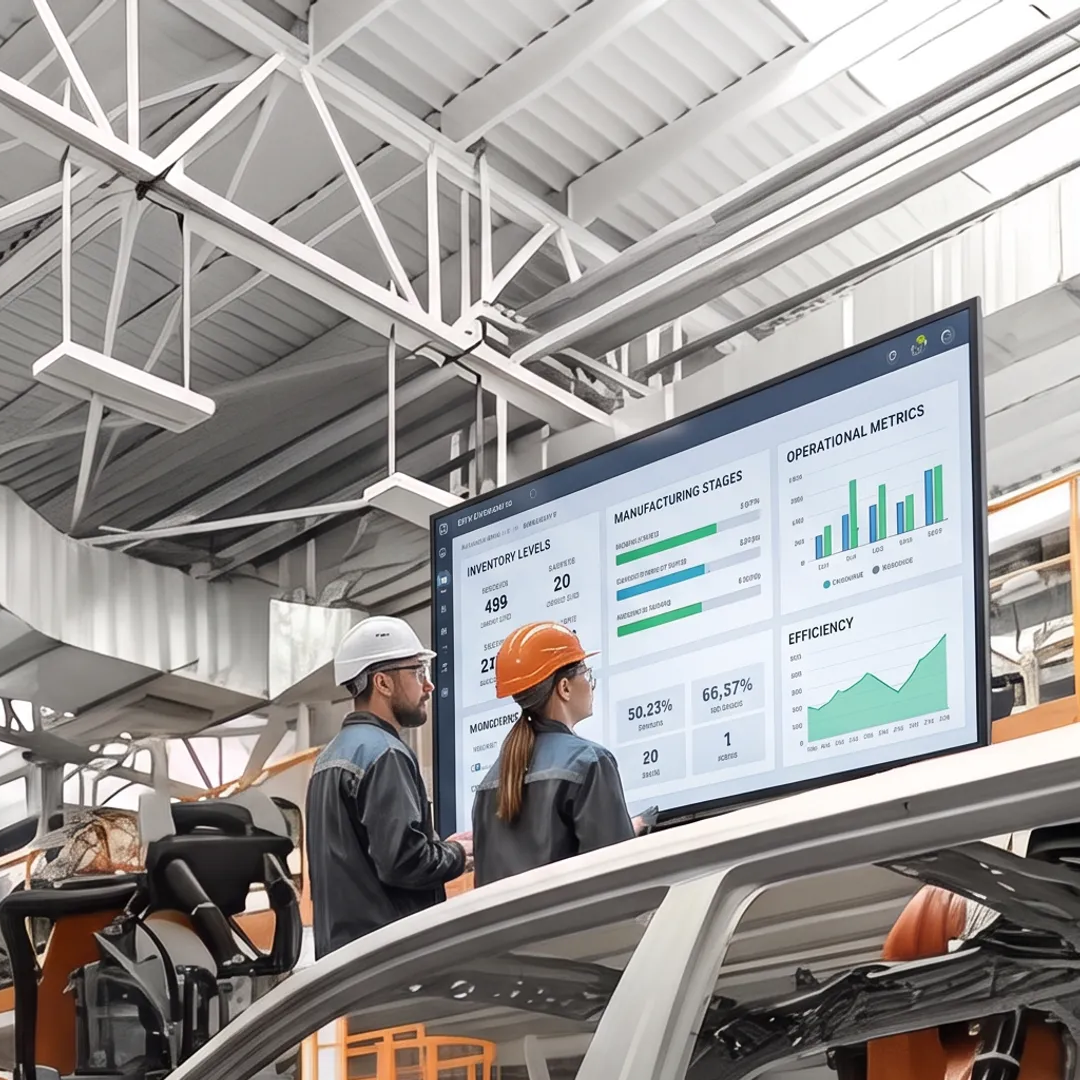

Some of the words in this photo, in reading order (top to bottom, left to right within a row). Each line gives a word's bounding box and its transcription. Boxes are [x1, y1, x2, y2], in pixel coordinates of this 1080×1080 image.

[786, 425, 868, 463] OPERATIONAL
[870, 404, 925, 435] METRICS
[614, 485, 700, 524] MANUFACTURING
[702, 470, 743, 494] STAGES
[467, 551, 516, 577] INVENTORY
[518, 538, 551, 560] LEVELS
[553, 573, 571, 592] 20
[485, 594, 508, 614] 499
[788, 616, 854, 645] EFFICIENCY
[628, 698, 673, 721] 50.23%
[724, 731, 731, 747] 1
[642, 749, 658, 765] 20
